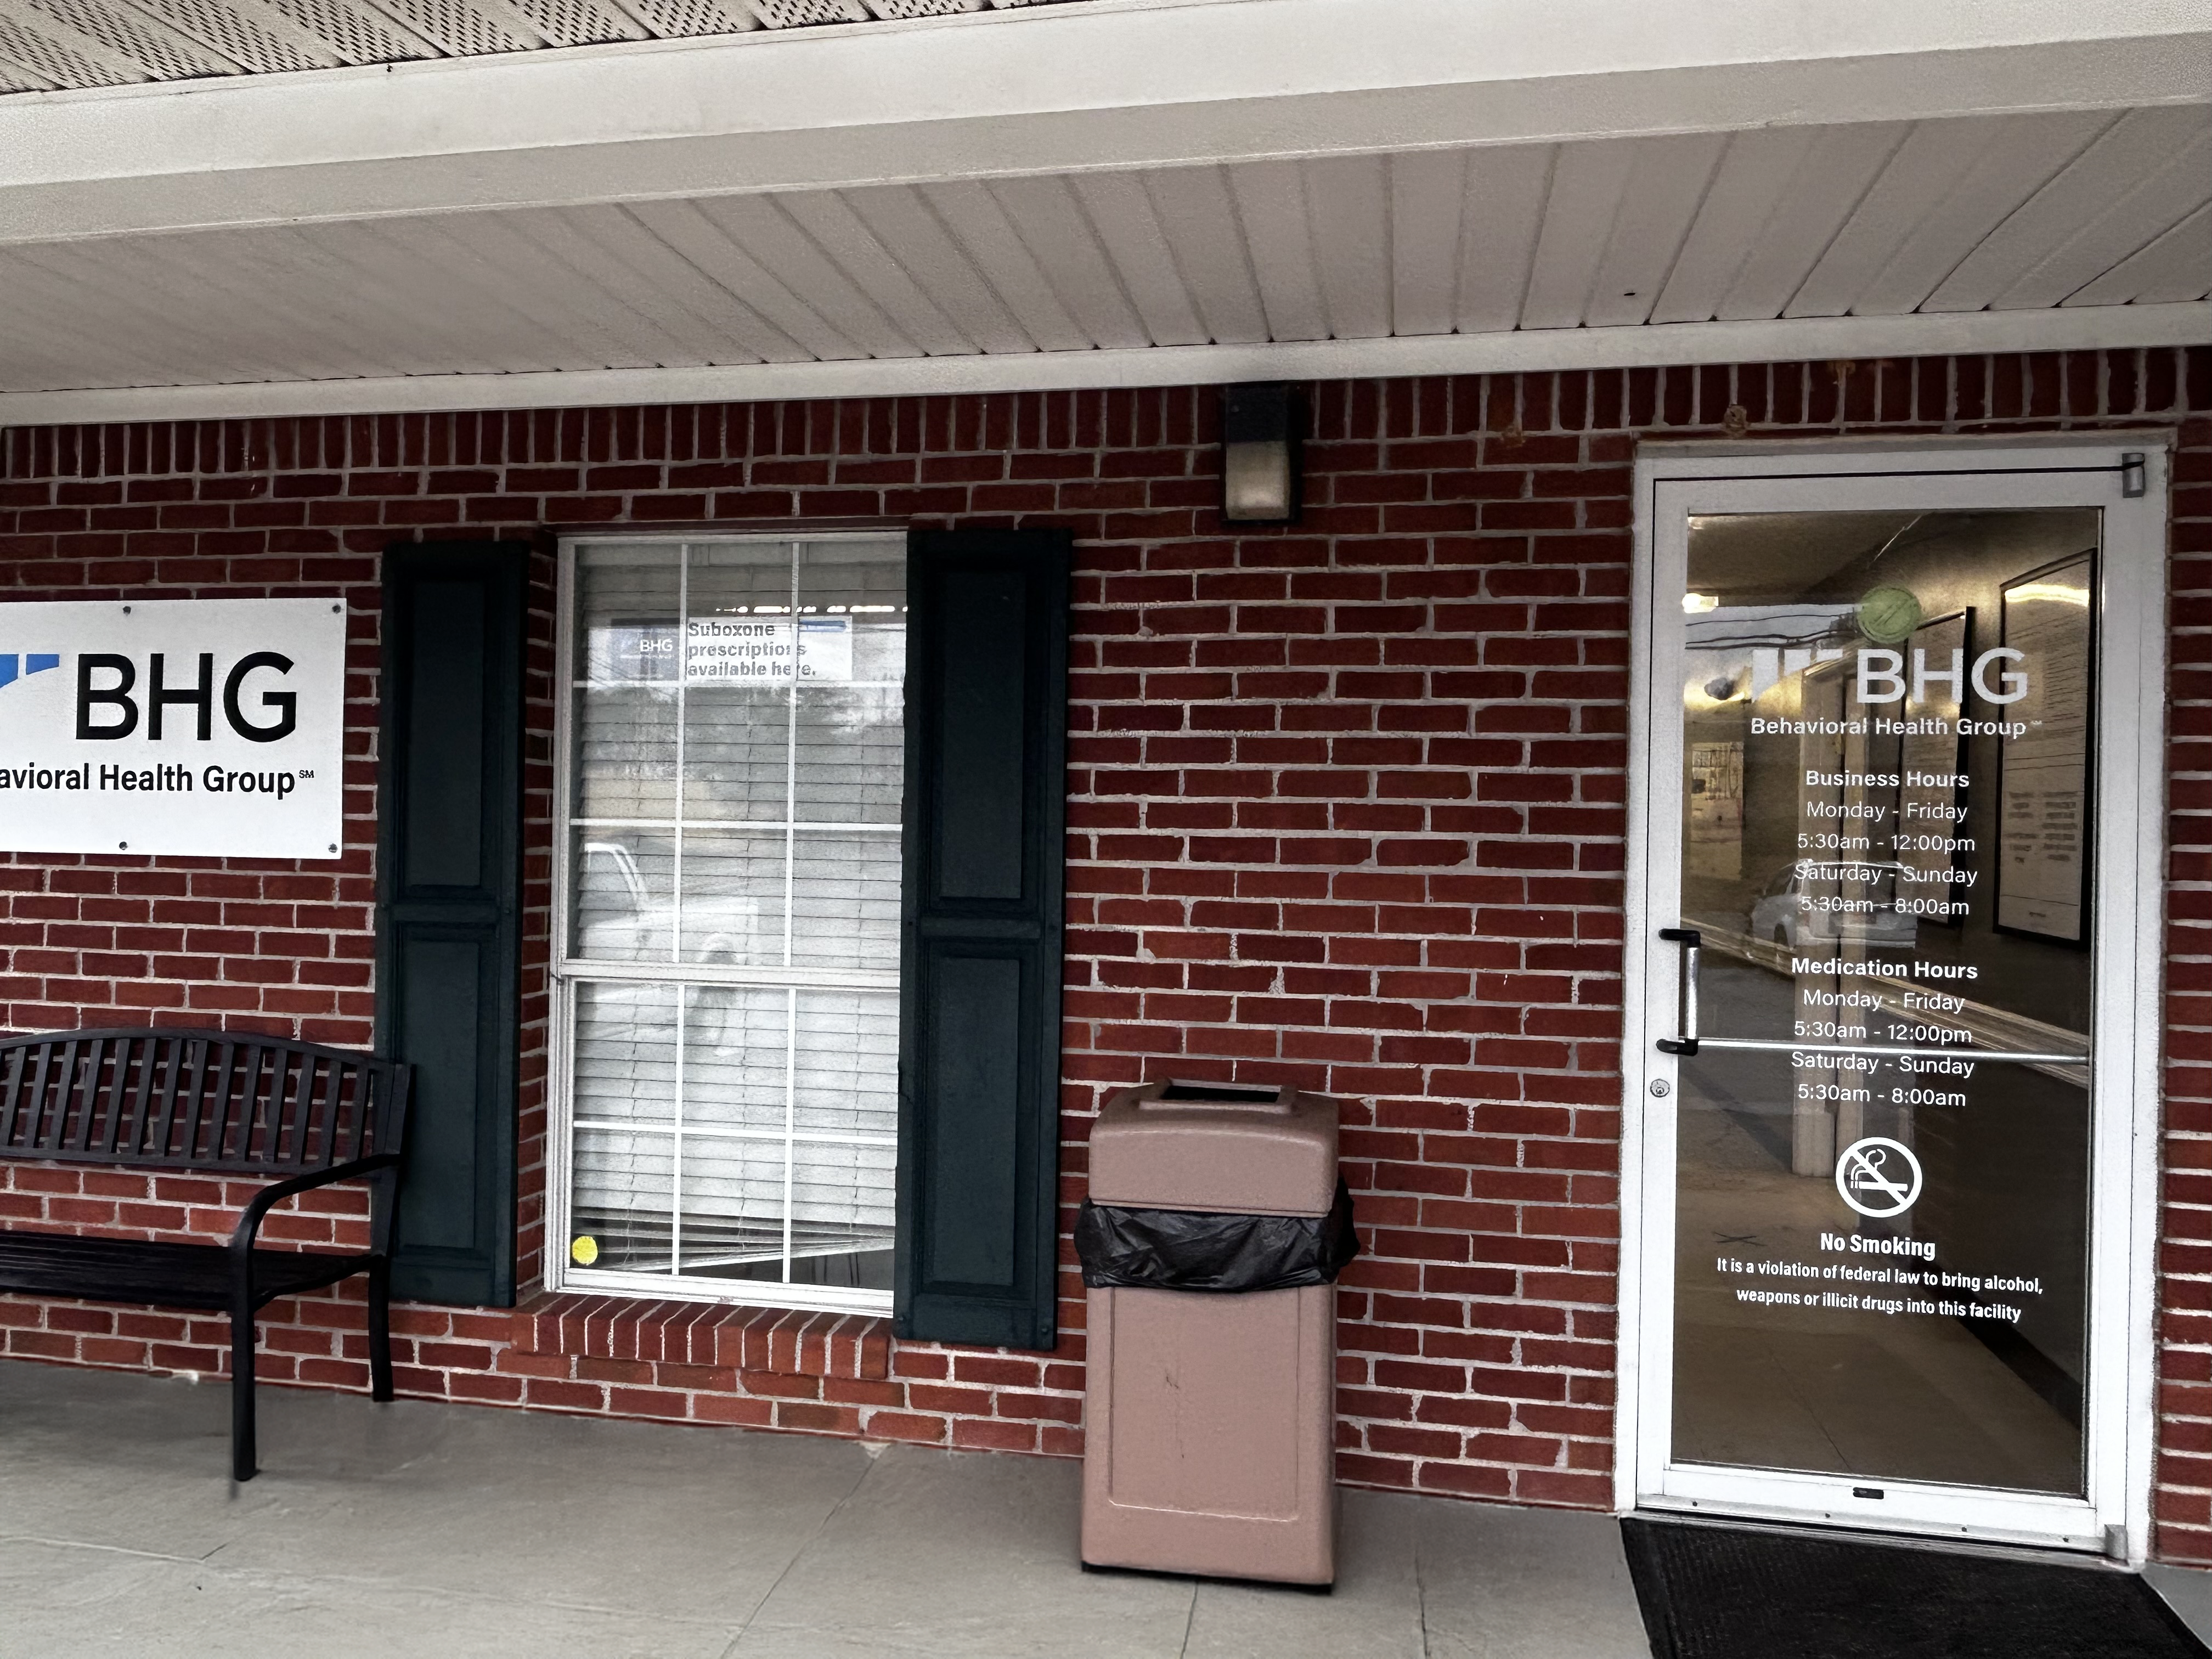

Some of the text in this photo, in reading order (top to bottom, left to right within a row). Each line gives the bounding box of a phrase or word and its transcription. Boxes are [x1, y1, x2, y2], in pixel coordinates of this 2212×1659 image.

[688, 621, 775, 637] Suboxone
[640, 639, 673, 652] BHG
[687, 661, 817, 677] available hee.
[1857, 647, 2028, 704] BHG
[76, 651, 297, 743] BHG
[1751, 718, 2027, 740] Behavioral Health Group
[100, 764, 193, 792] Health
[203, 765, 295, 800] Group
[1805, 770, 1970, 788] Business Hours
[1807, 801, 1886, 822] Monday
[1907, 802, 1968, 823] Friday
[1797, 833, 1870, 849] 5:30am
[1891, 835, 1976, 855] 12:00pm
[1795, 863, 1883, 885] Saturday
[1903, 866, 1978, 887] Sunday
[1801, 896, 1874, 912] 5:30am
[1895, 899, 1970, 915] 8:00am
[1791, 957, 1978, 979] Medication Hours
[1803, 989, 1883, 1012] Monday
[1904, 992, 1966, 1014] Friday
[1794, 1021, 1866, 1039] 5:30am
[1888, 1024, 1972, 1046] 12:00pm
[1791, 1051, 1879, 1075] Saturday
[1899, 1056, 1974, 1079] Sunday
[1798, 1084, 1870, 1102] 5:30am
[1892, 1088, 1966, 1107] 8:00am
[1820, 1232, 1936, 1261] No Smoking
[1717, 1257, 2044, 1295] It is a violation of federal law to bring alcohol,
[1736, 1289, 2022, 1324] weapons or illicit drugs into this facility
